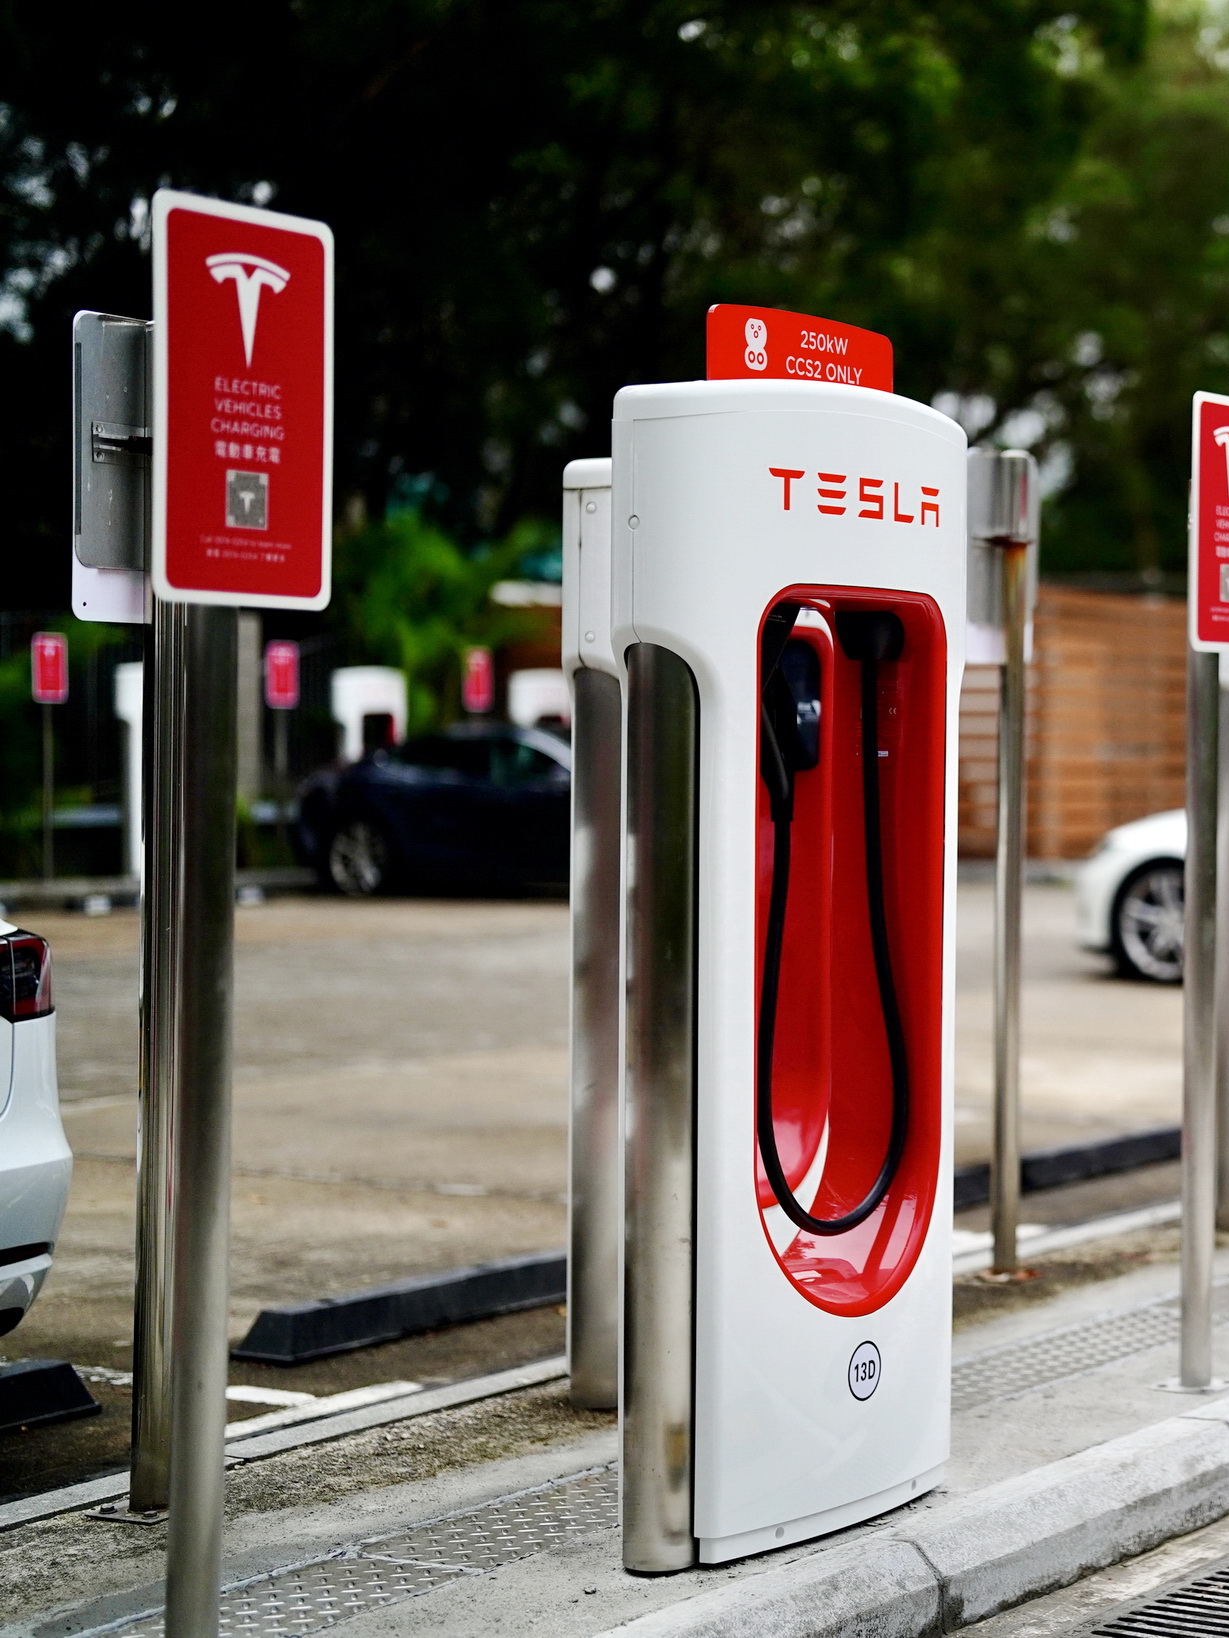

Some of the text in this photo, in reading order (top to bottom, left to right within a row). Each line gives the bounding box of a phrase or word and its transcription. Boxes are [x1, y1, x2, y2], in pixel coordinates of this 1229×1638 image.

[800, 330, 849, 356] 250kW
[785, 355, 863, 386] CCS2 ONLY
[214, 376, 281, 399] ELECTRIC
[214, 398, 282, 420] VEHICLES
[210, 417, 285, 441] CHARGING
[768, 467, 940, 528] TESLA
[854, 1359, 876, 1383] 13D
